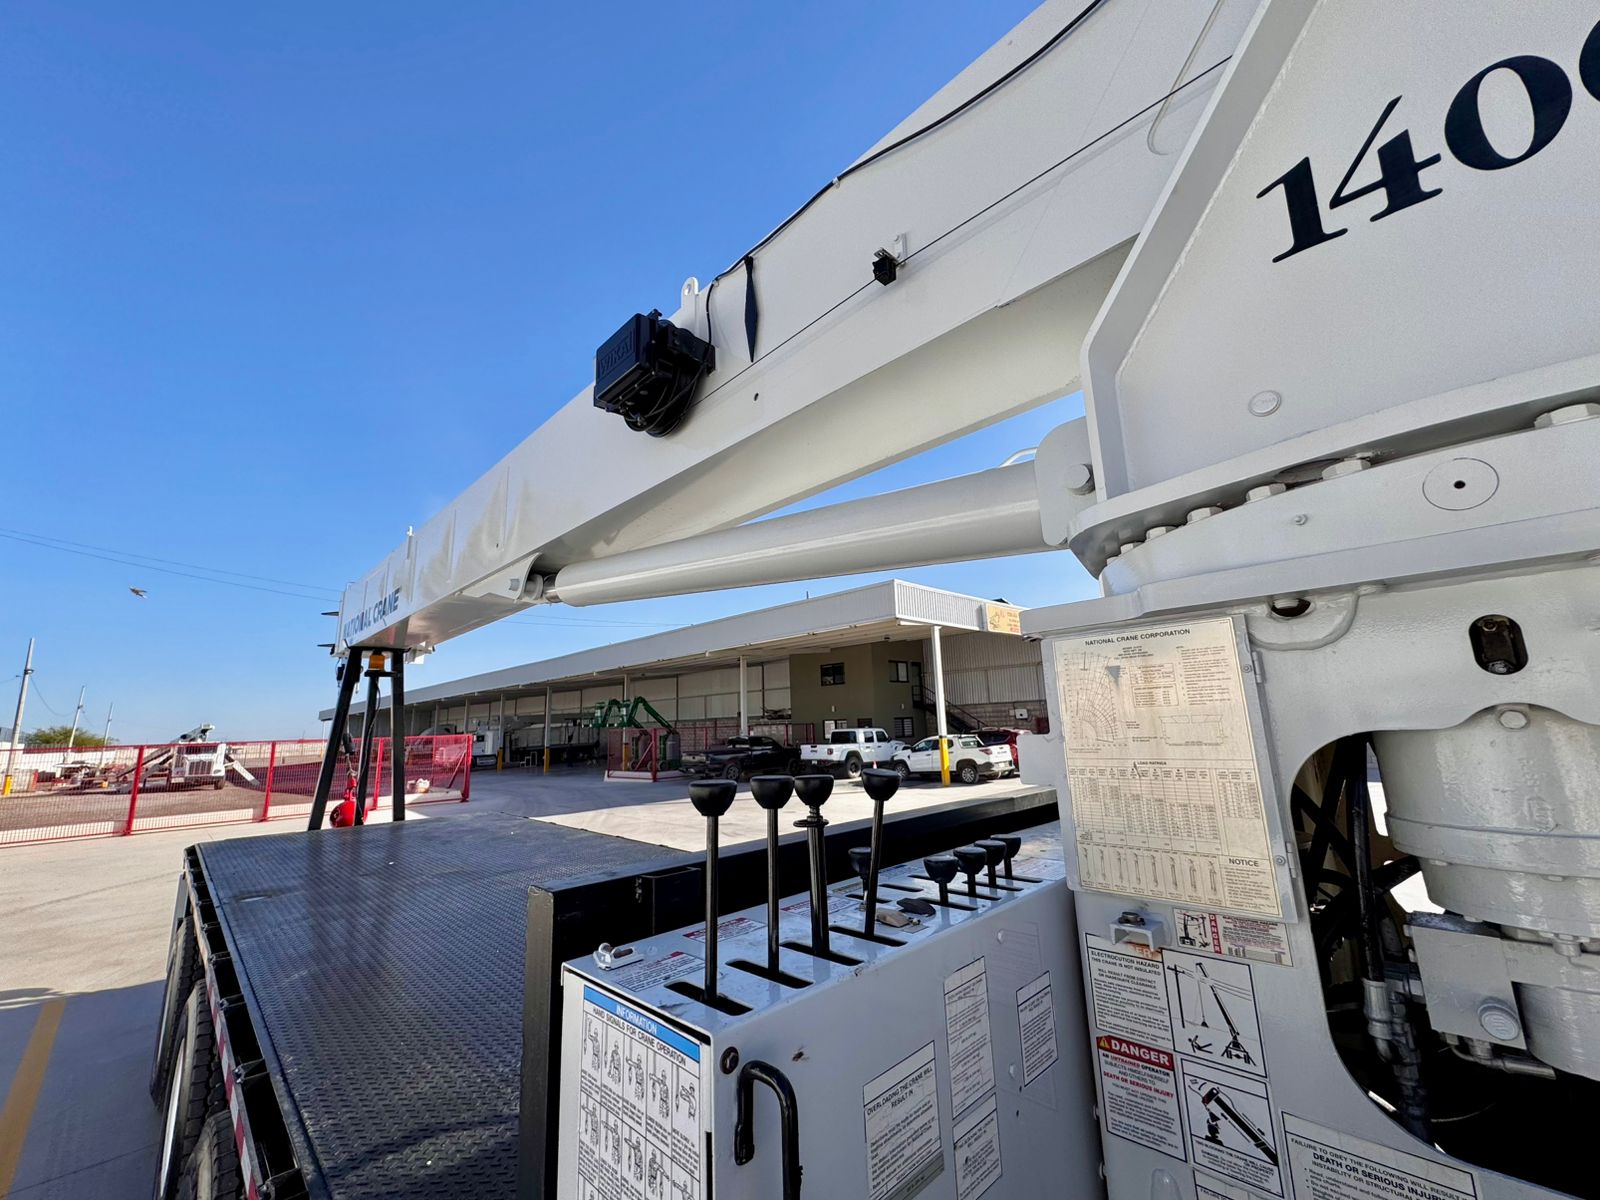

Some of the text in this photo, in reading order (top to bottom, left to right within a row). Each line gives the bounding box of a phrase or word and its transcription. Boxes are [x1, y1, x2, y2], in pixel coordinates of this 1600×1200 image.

[1256, 19, 1600, 263] 140
[344, 586, 402, 639] NATIONAL CRANE
[1085, 628, 1190, 646] NATIONAL CRANE CORPORATION
[1228, 858, 1259, 867] NOTICE
[1091, 951, 1160, 970] ELECTROCUTION HAZARD
[1134, 966, 1161, 976] INSULATED
[616, 1004, 657, 1035] INFORMATION
[592, 1006, 686, 1067] HAND SIGNALS FOR CRANE OPERATION
[1104, 1060, 1126, 1070] SUBJECTS
[1111, 1039, 1170, 1066] DANGER
[1111, 1055, 1140, 1068] UNTRAINED
[1141, 1064, 1170, 1077] OPERATOR
[867, 1065, 933, 1116] OVERLOADING THE CRANE WILL
[1103, 1071, 1119, 1080] DEATH
[1130, 1079, 1152, 1091] SERIOUS
[1153, 1087, 1174, 1099] INJURY
[1129, 1072, 1148, 1083] OTHERS
[891, 1088, 914, 1108] RESULT IN
[1290, 1137, 1460, 1200] FAILURE TO OBEY THE FOLLOWING WILL RESULT
[1311, 1160, 1352, 1179] INSTABILITY
[1353, 1175, 1364, 1183] OR
[1365, 1180, 1413, 1200] STRUCTURAL
[1313, 1152, 1343, 1169] DEATH
[1345, 1164, 1359, 1174] OR
[1361, 1169, 1405, 1190] SERIOUS
